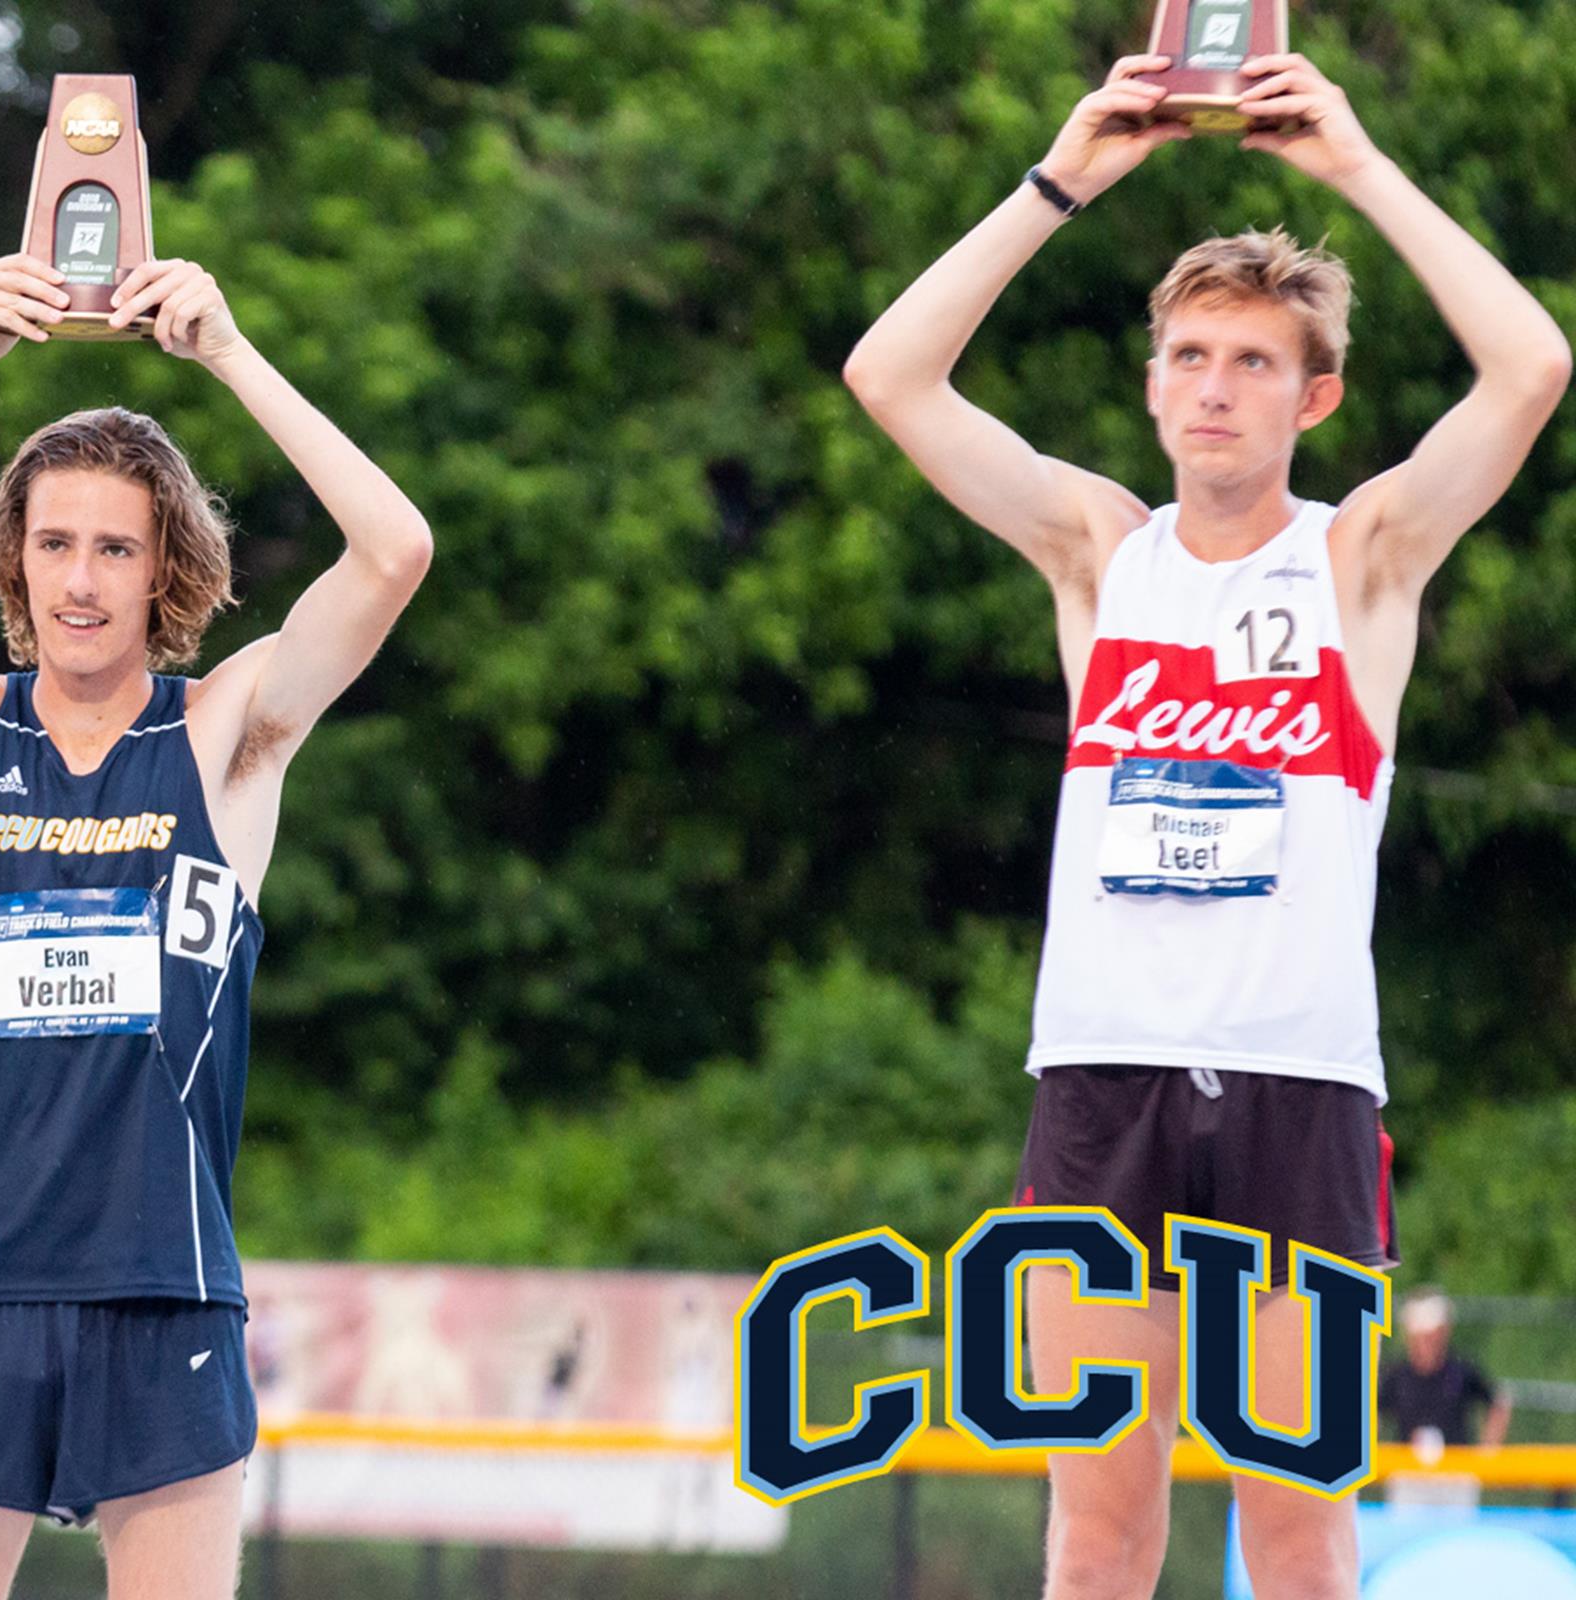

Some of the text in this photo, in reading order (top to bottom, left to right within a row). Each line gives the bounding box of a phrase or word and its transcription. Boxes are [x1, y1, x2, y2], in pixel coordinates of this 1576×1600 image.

[65, 119, 121, 138] NCAA
[1235, 607, 1300, 674] 12
[1073, 659, 1331, 756] Lewis
[39, 812, 177, 855] COUGARS
[1151, 812, 1231, 837] Michael
[1158, 839, 1221, 870] Leet
[179, 865, 220, 954] 5
[44, 948, 89, 968] Evan
[18, 972, 116, 1008] Verbal
